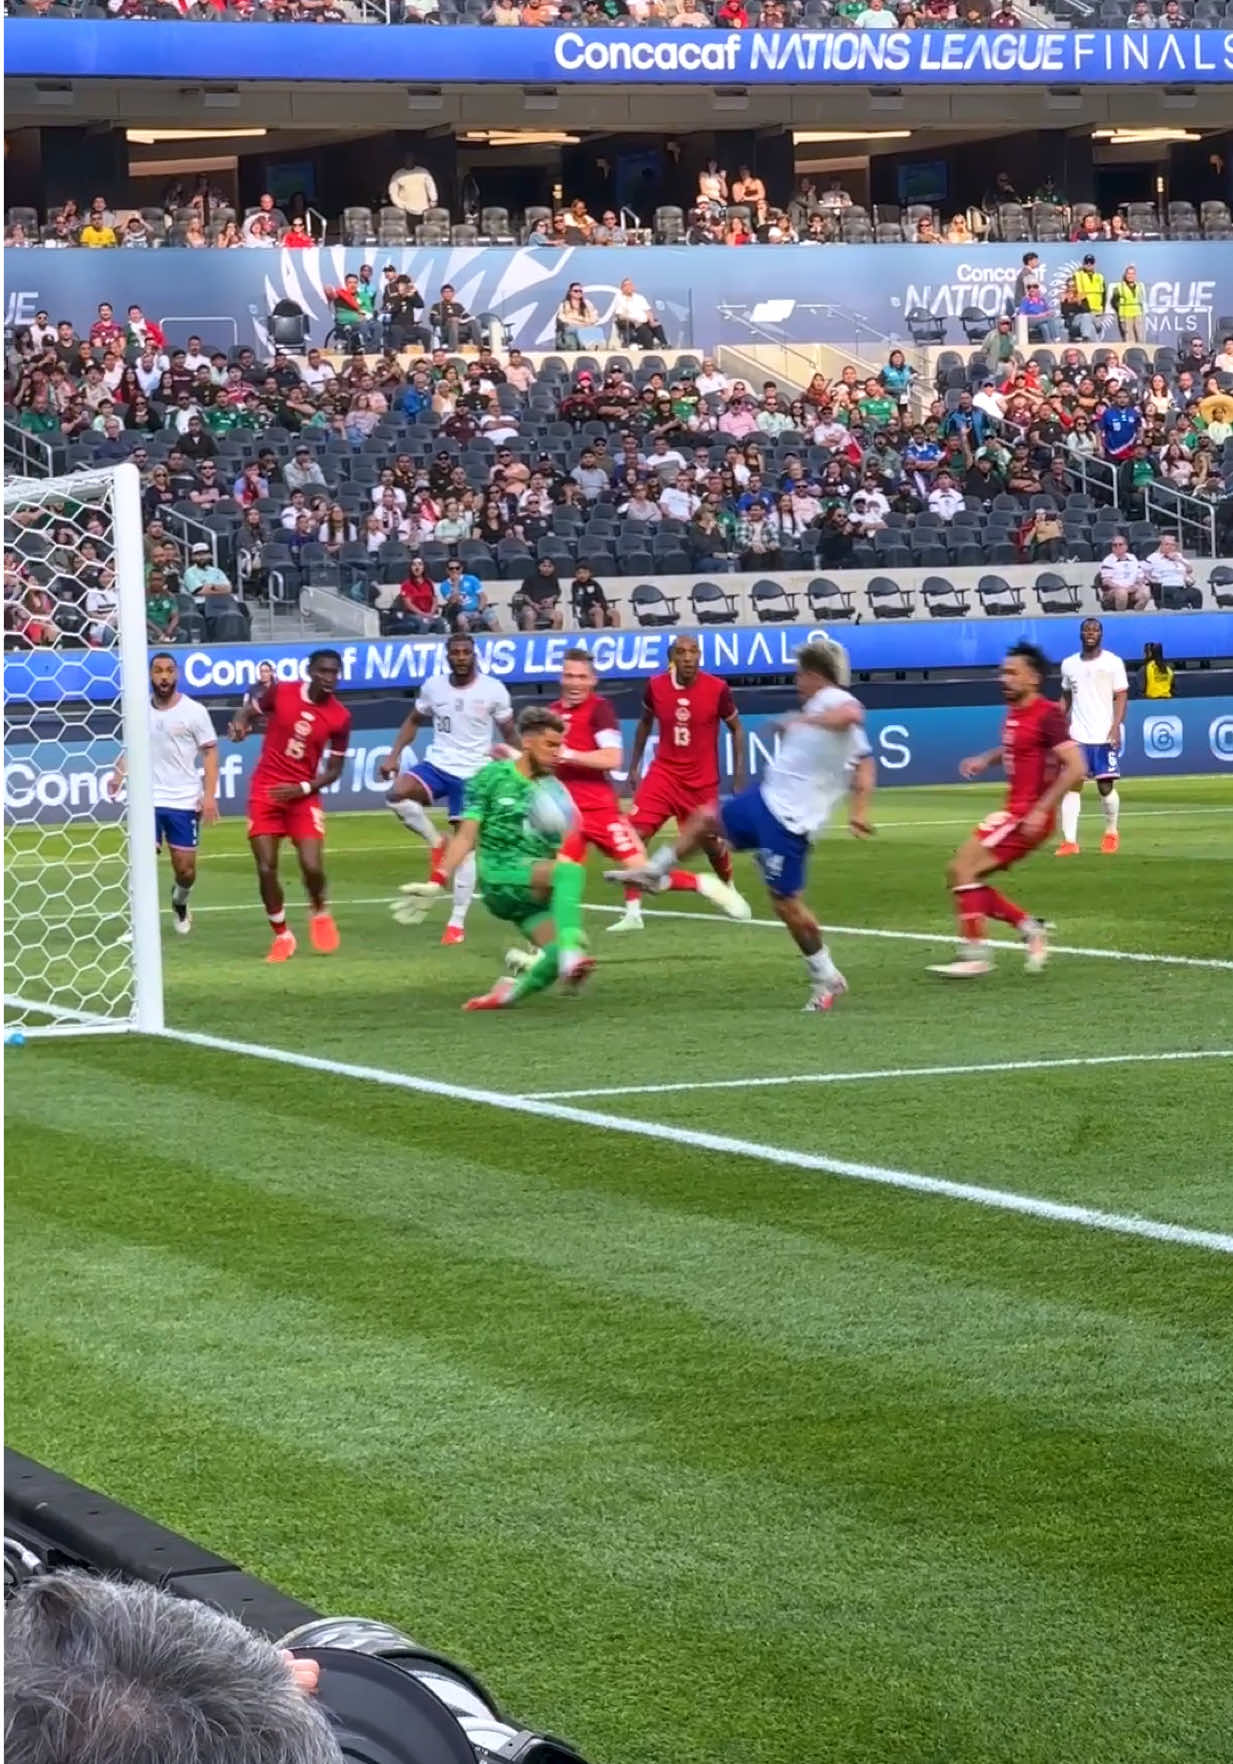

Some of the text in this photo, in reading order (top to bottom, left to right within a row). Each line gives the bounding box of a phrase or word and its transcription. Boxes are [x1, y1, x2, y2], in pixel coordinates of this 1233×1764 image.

[555, 32, 741, 70] Concacaf
[751, 33, 911, 70] NATIONS
[920, 34, 1065, 70] LEAGUE
[956, 263, 1047, 282] Concaf
[904, 284, 1047, 316] NATION
[185, 647, 358, 688] Conacf
[364, 639, 517, 680] NATINS
[669, 630, 831, 666] INAL
[673, 727, 691, 746] 13
[284, 738, 306, 760] 15
[1107, 751, 1118, 767] 6
